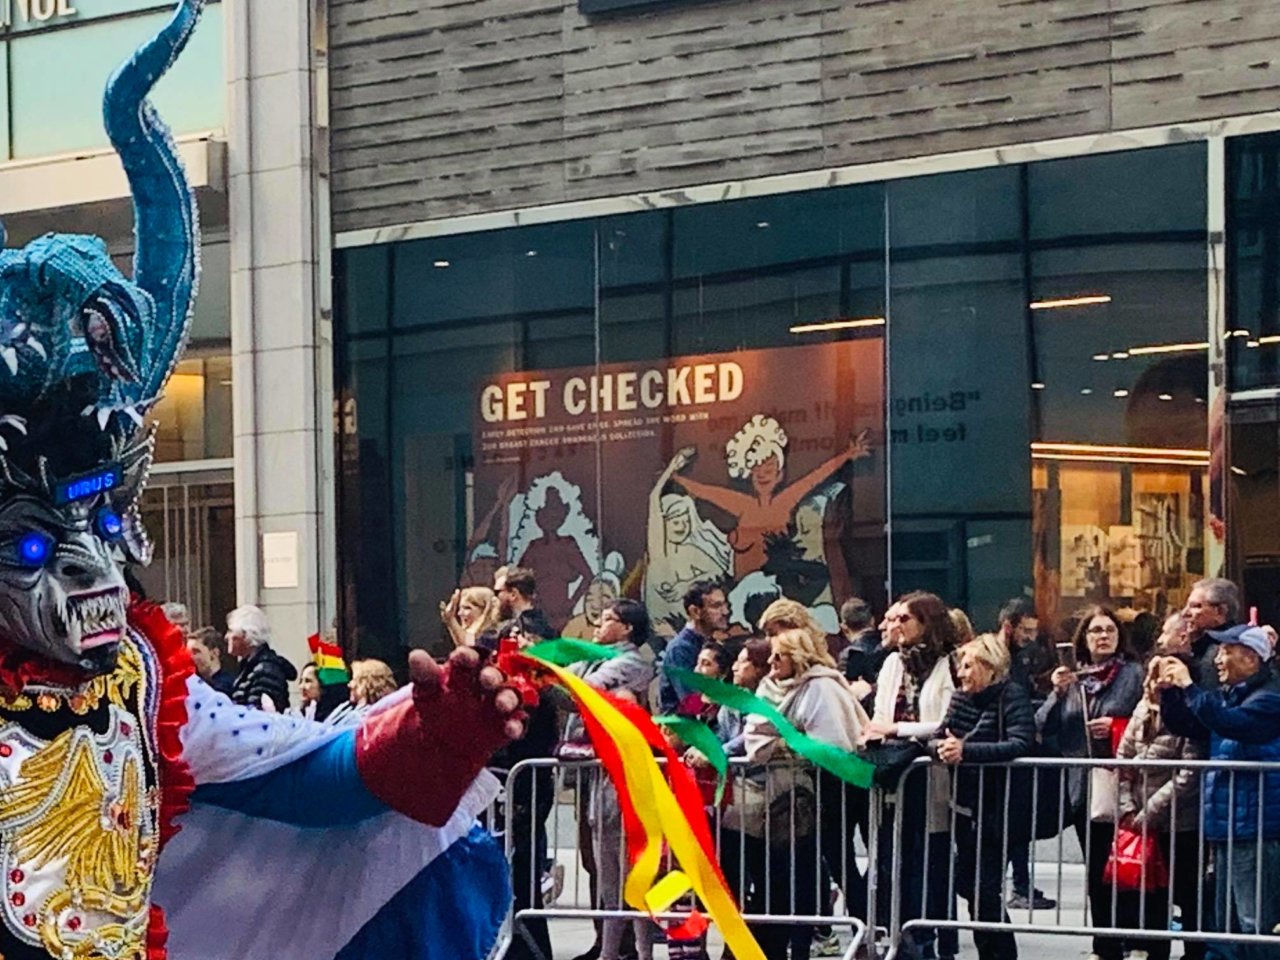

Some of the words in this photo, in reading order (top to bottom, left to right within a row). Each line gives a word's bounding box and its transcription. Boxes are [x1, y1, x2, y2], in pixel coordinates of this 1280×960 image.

[481, 379, 551, 422] GET
[564, 362, 744, 415] CHECKED
[68, 473, 115, 499] URUS
